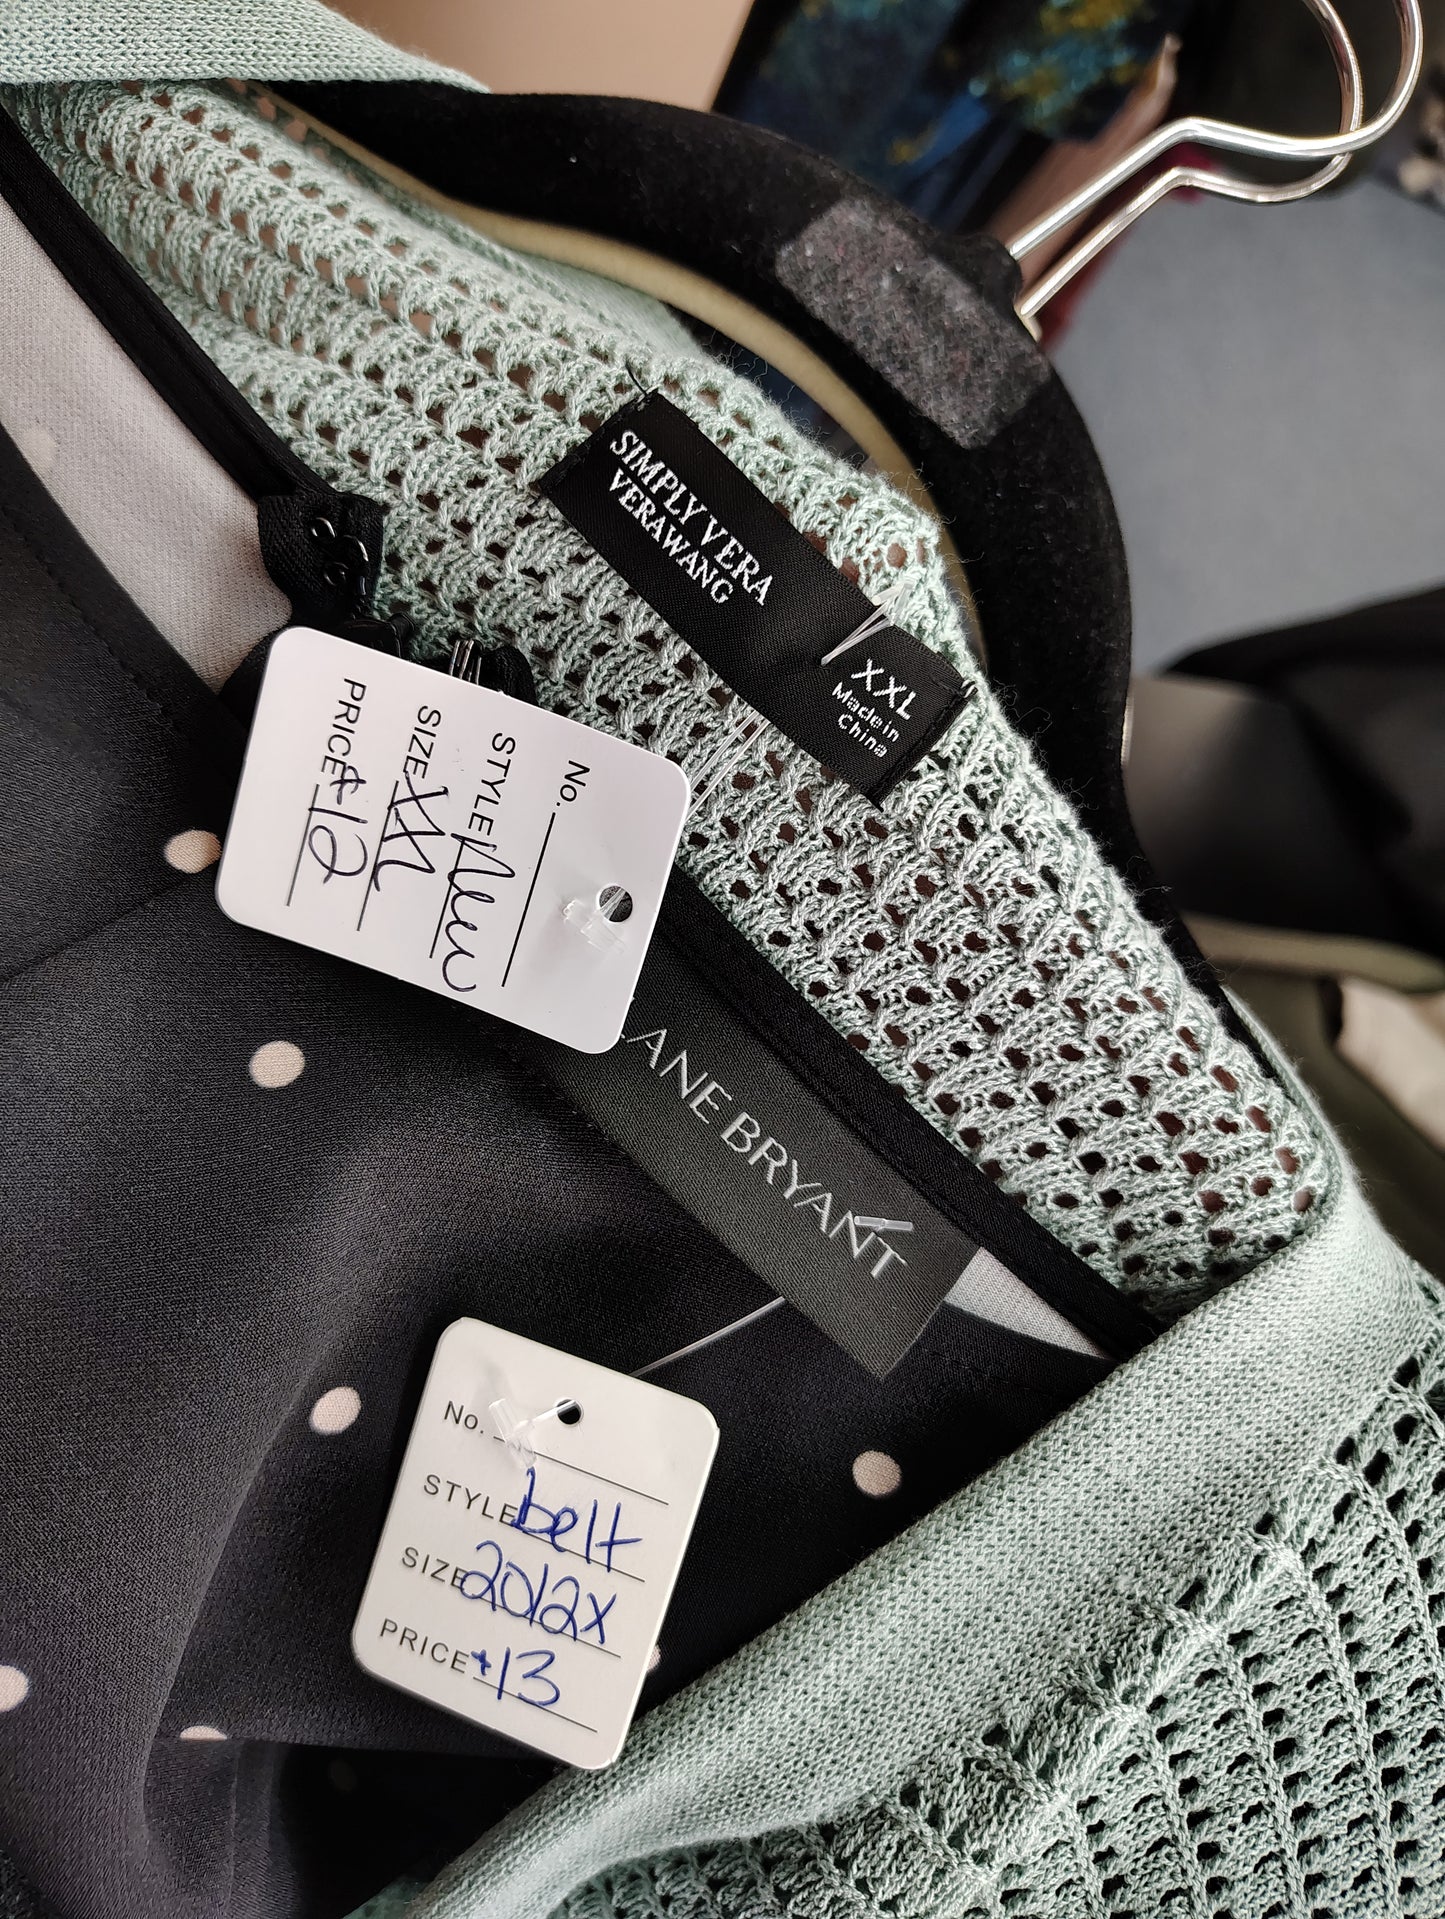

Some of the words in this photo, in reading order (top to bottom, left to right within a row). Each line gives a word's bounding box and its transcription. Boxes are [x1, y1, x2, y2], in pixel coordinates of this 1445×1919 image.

[610, 429, 708, 525] SIMPLY
[700, 515, 774, 606] VERA
[832, 681, 883, 729] Made
[882, 720, 899, 742] in
[850, 658, 916, 720] XXL
[321, 678, 367, 776] PRICE
[405, 705, 442, 780] SIZE
[838, 714, 887, 757] China
[468, 732, 516, 836] STYLE
[555, 760, 590, 808] No.
[620, 1029, 732, 1124] ANE
[720, 1112, 908, 1279] BRYANT
[443, 1400, 484, 1435] No.
[423, 1474, 518, 1526] STYLE
[510, 1466, 643, 1573] belt
[401, 1546, 467, 1590] SIZE
[379, 1618, 470, 1675] PRICE
